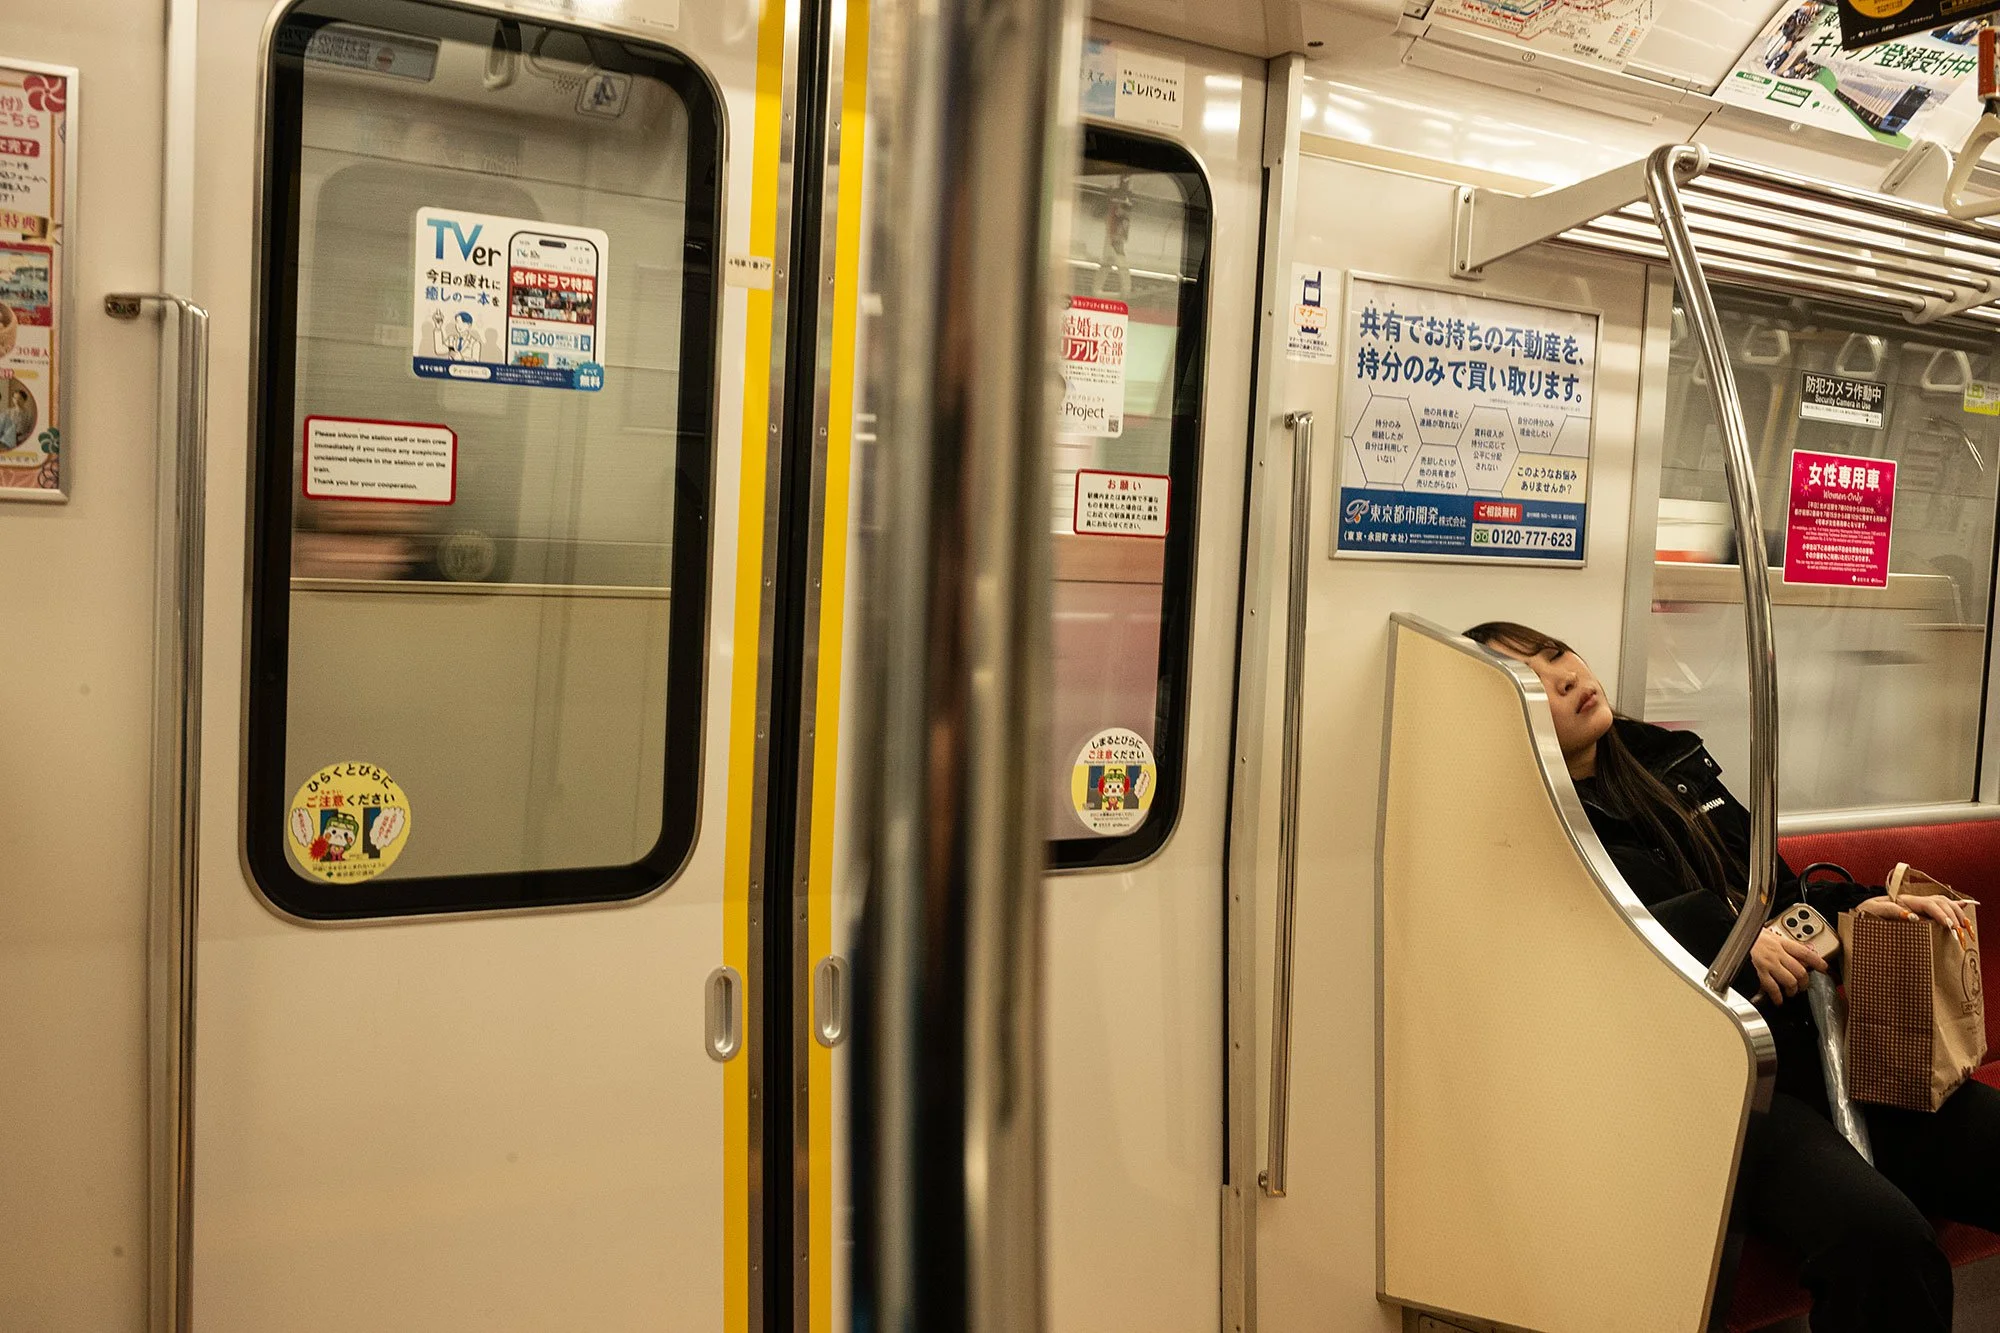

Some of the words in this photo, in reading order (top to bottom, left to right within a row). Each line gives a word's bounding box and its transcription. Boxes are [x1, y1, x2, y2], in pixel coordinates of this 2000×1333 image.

[1137, 84, 1176, 102] レバウェル
[427, 218, 502, 267] TVer
[426, 268, 501, 291] 今日の疲れに
[512, 269, 594, 293] 名作ドラマ特集
[425, 286, 500, 308] 癒しの一本を
[532, 331, 555, 347] 500
[1360, 306, 1584, 365] 共有でお持ちの不動産を、
[1357, 346, 1582, 403] 持分のみで買い取ります。
[1806, 376, 1881, 403] 防犯カメラ作動中
[1815, 394, 1835, 406] Security
[1836, 397, 1855, 408] Camera
[1861, 401, 1871, 410] Use
[1065, 402, 1105, 421] Project
[1424, 406, 1459, 418] 他の共有者と
[1376, 419, 1401, 430] 持分のみ
[1420, 419, 1462, 430] 連絡が取れない
[315, 430, 336, 438] Please
[338, 431, 358, 439] inform
[315, 443, 354, 452] immediately
[412, 449, 446, 457] suspicious
[1365, 441, 1408, 453] 自分は利用して
[314, 454, 347, 462] unclaimed
[349, 456, 372, 464] objects
[436, 460, 446, 468] the
[1377, 455, 1396, 464] いない
[1419, 468, 1456, 479] 他の共有者が
[1517, 466, 1577, 481] このようなお悩み
[1808, 461, 1880, 491] 女性専用車
[314, 477, 334, 485] Thank
[336, 479, 348, 487] you
[350, 478, 358, 486] for
[361, 480, 376, 488] your
[378, 481, 417, 489] cooperation.
[1108, 479, 1141, 491] お願い
[1823, 489, 1846, 501] Women
[1847, 492, 1863, 504] Only
[1479, 505, 1517, 519] ご相談無料
[1491, 528, 1573, 547] 0120-777-623
[1092, 735, 1142, 749] しまるとびらに
[1088, 749, 1144, 760] ご注意ください
[306, 763, 393, 793] ひらくとびらに
[307, 793, 395, 808] ご注意ください
